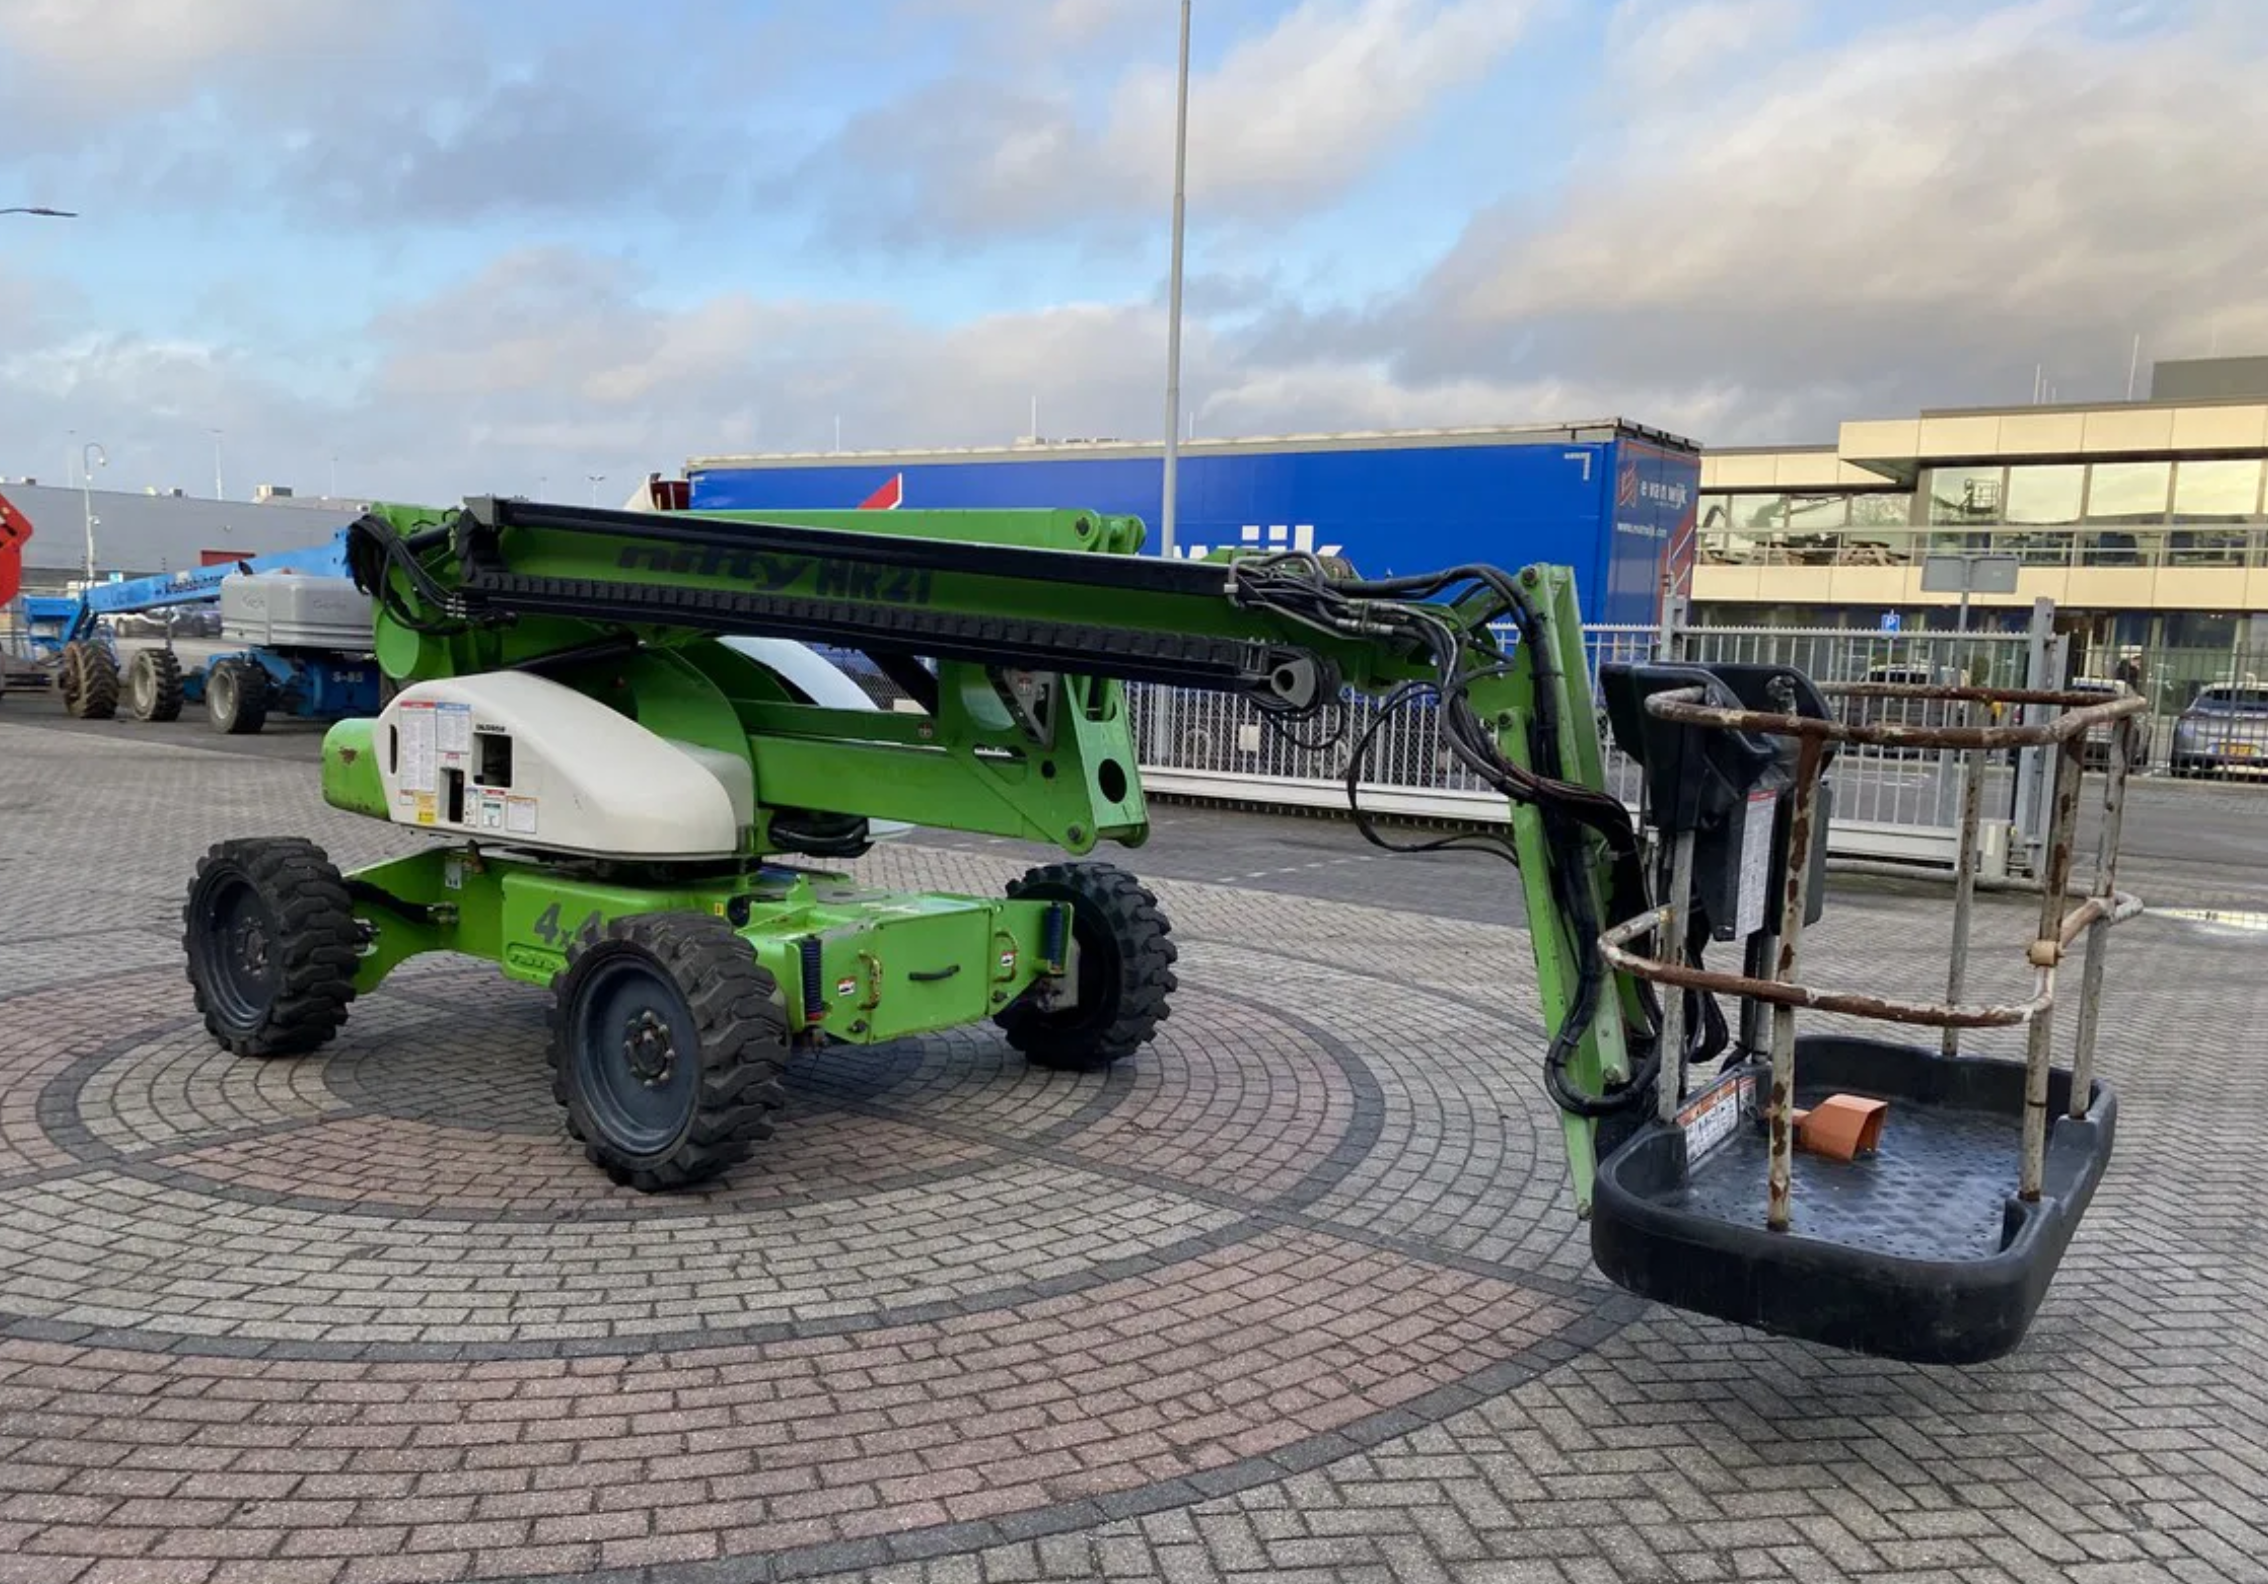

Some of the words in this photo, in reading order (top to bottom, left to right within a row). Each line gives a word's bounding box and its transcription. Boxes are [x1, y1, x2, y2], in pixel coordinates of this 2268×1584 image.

[1641, 480, 1648, 496] e
[617, 546, 812, 591] nifty
[815, 558, 931, 605] HR21
